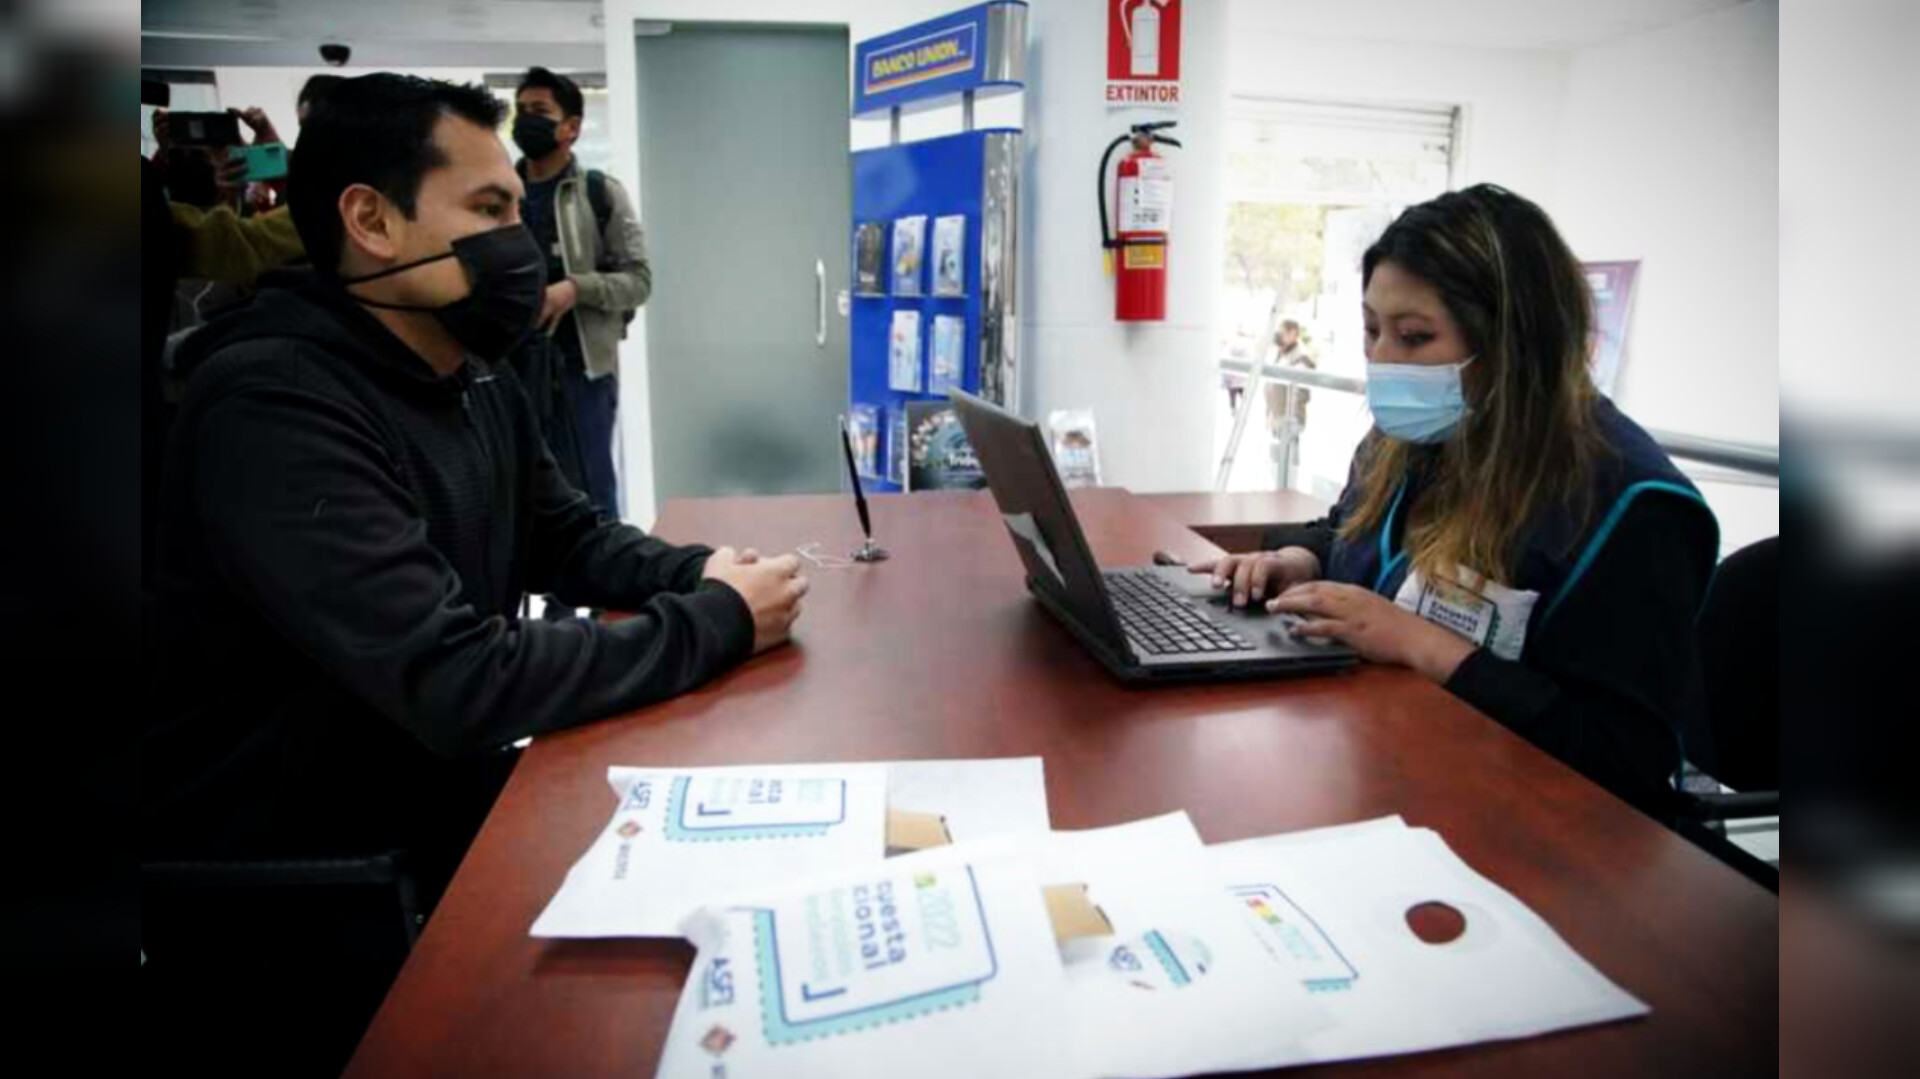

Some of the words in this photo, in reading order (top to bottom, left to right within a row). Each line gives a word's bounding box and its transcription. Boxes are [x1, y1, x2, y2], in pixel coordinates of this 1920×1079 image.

[872, 51, 915, 78] BANCO
[1106, 85, 1179, 101] EXTINTOR
[915, 885, 962, 952] 2022
